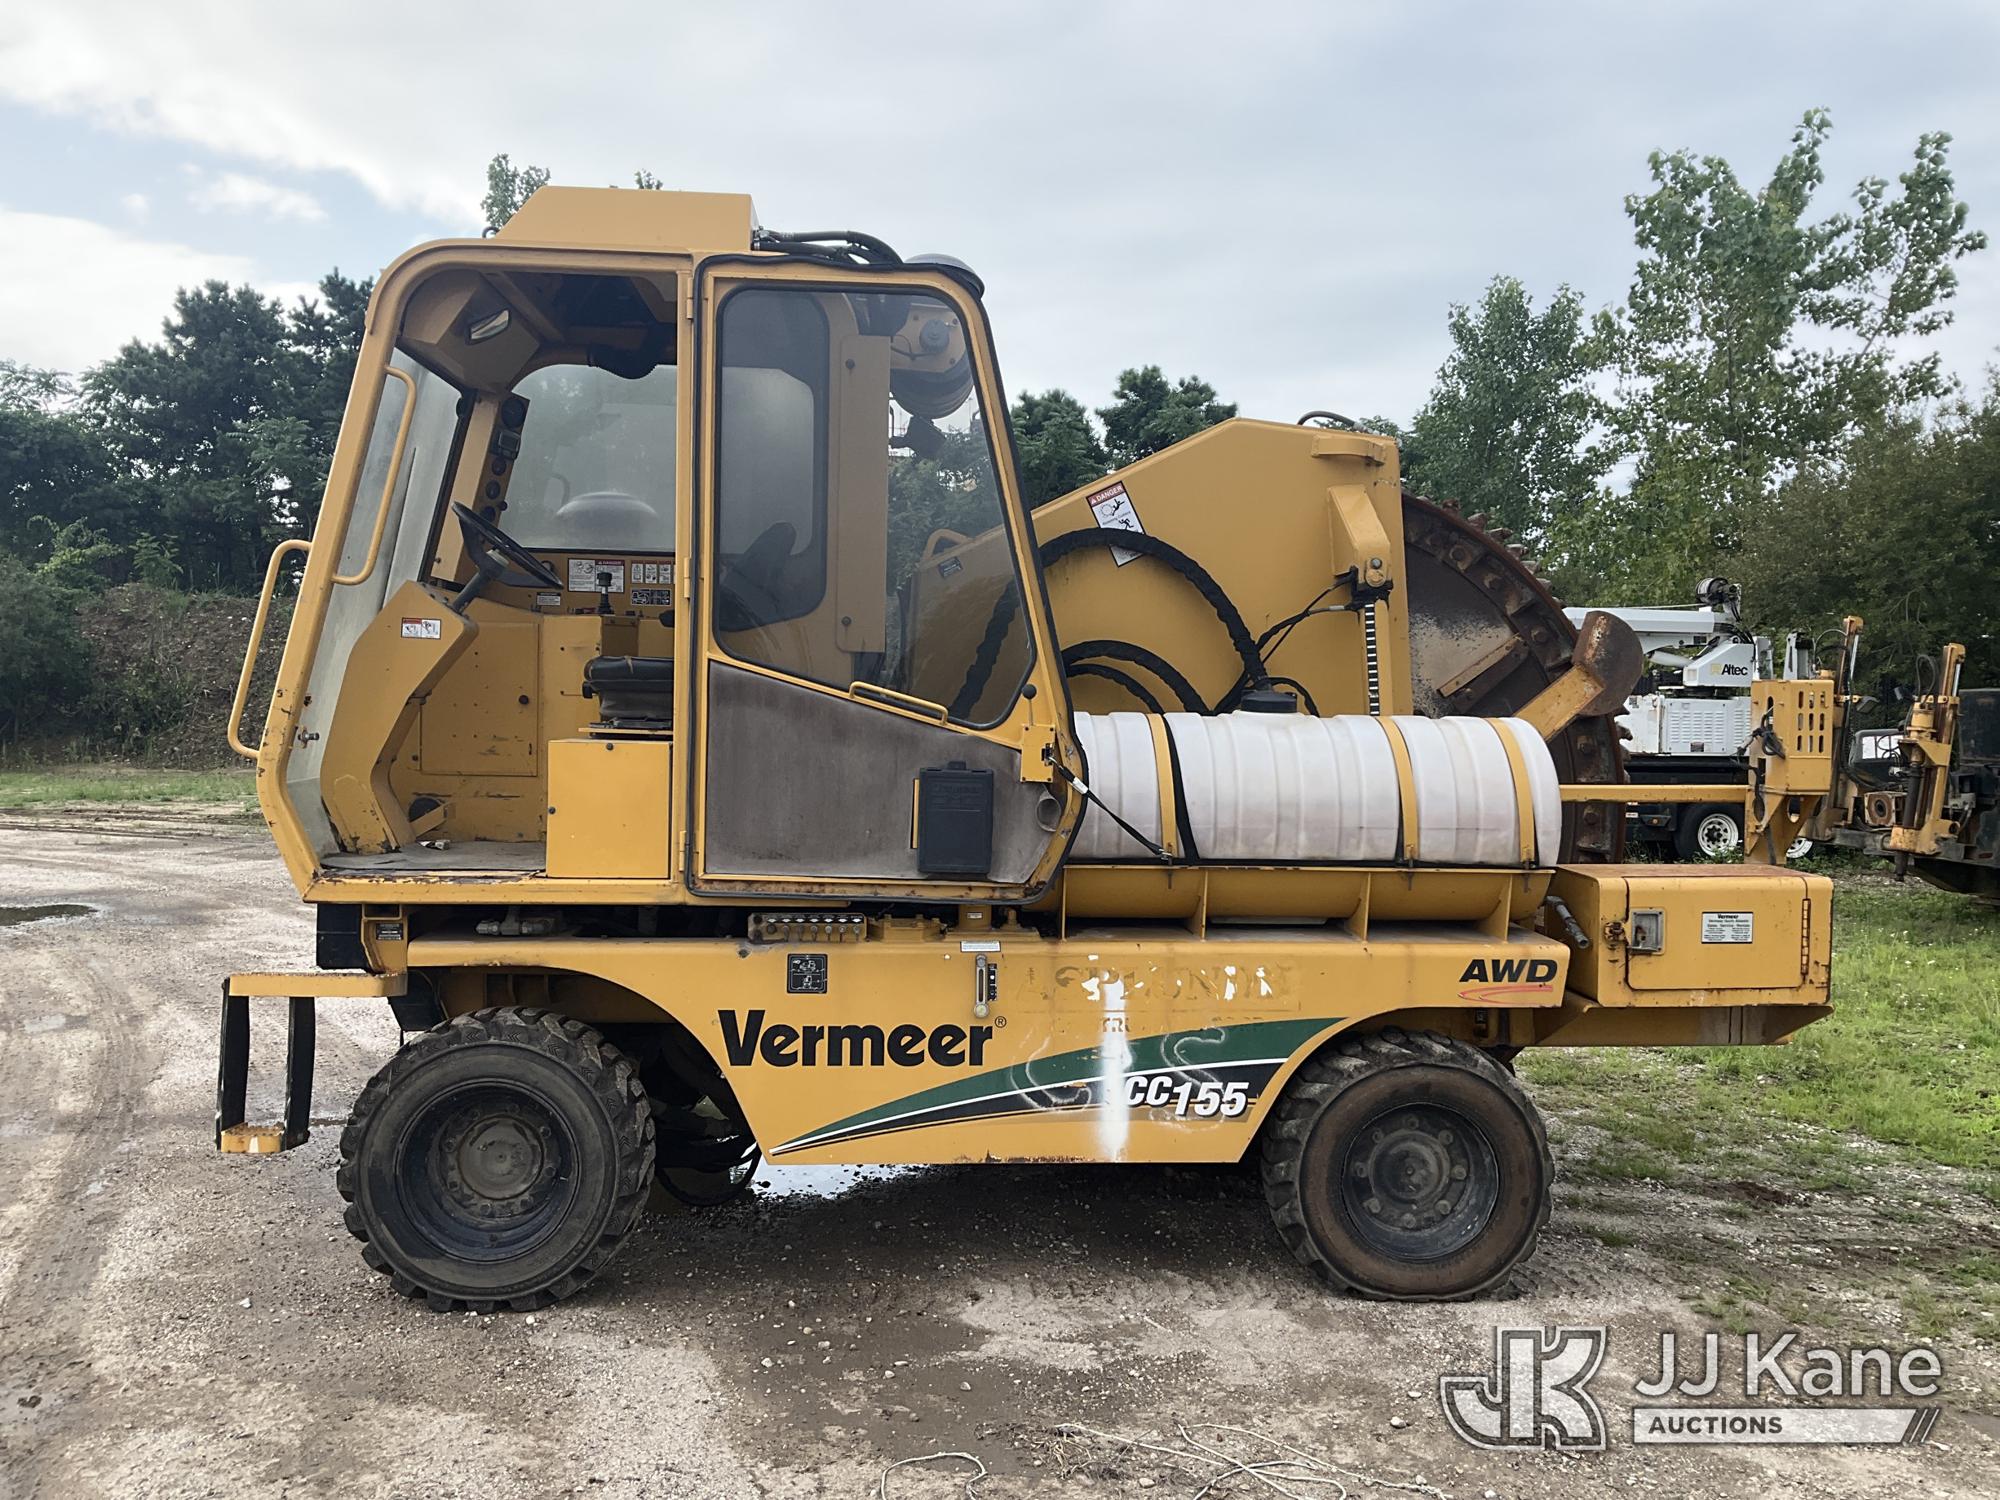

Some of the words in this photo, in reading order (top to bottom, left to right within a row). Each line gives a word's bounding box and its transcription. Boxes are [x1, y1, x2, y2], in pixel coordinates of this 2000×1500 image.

[1096, 485, 1123, 502] DANGER
[1721, 663, 1748, 676] Altec
[1459, 959, 1558, 983] AWD
